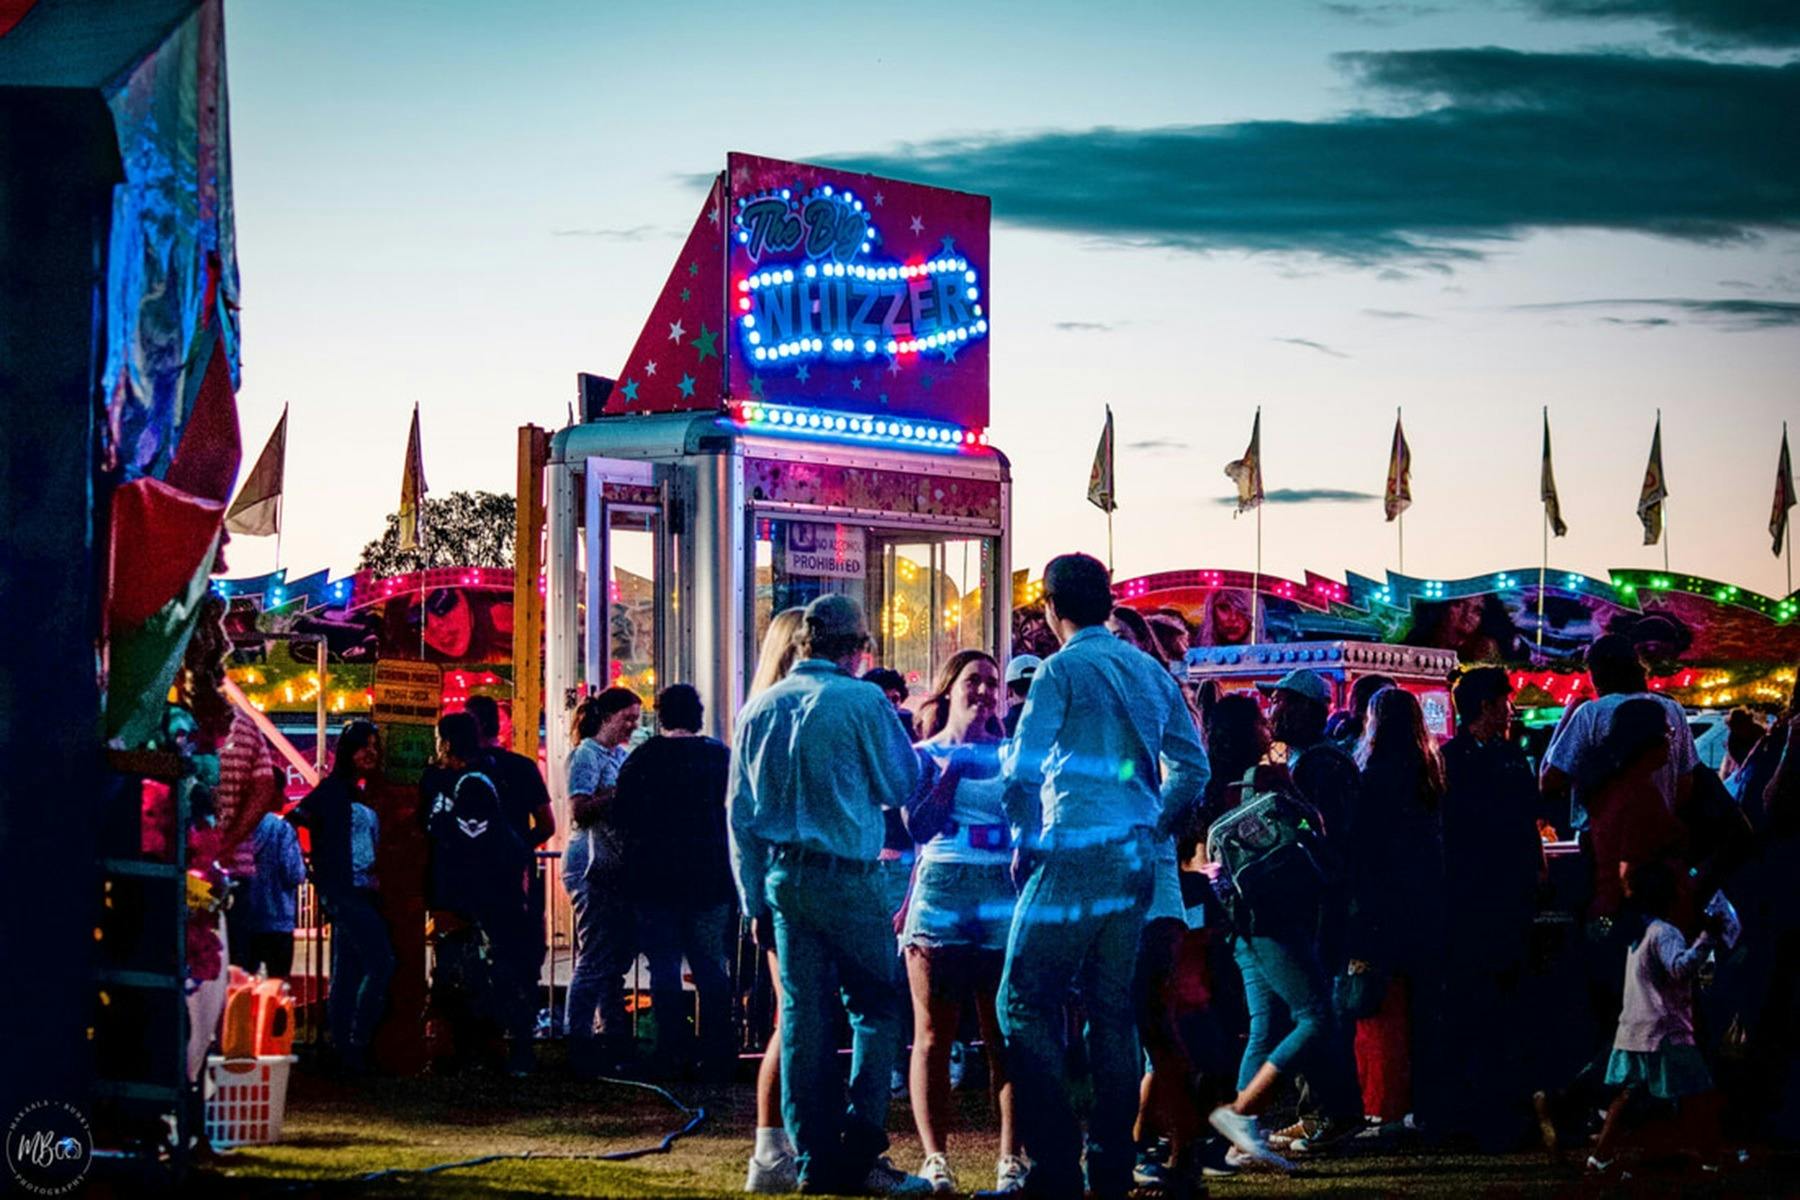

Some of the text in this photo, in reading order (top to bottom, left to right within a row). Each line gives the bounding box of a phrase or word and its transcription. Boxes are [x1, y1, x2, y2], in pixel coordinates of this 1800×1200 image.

[742, 198, 867, 263] The Big
[755, 276, 970, 342] WHIZZER
[793, 554, 860, 573] PROHIBITED
